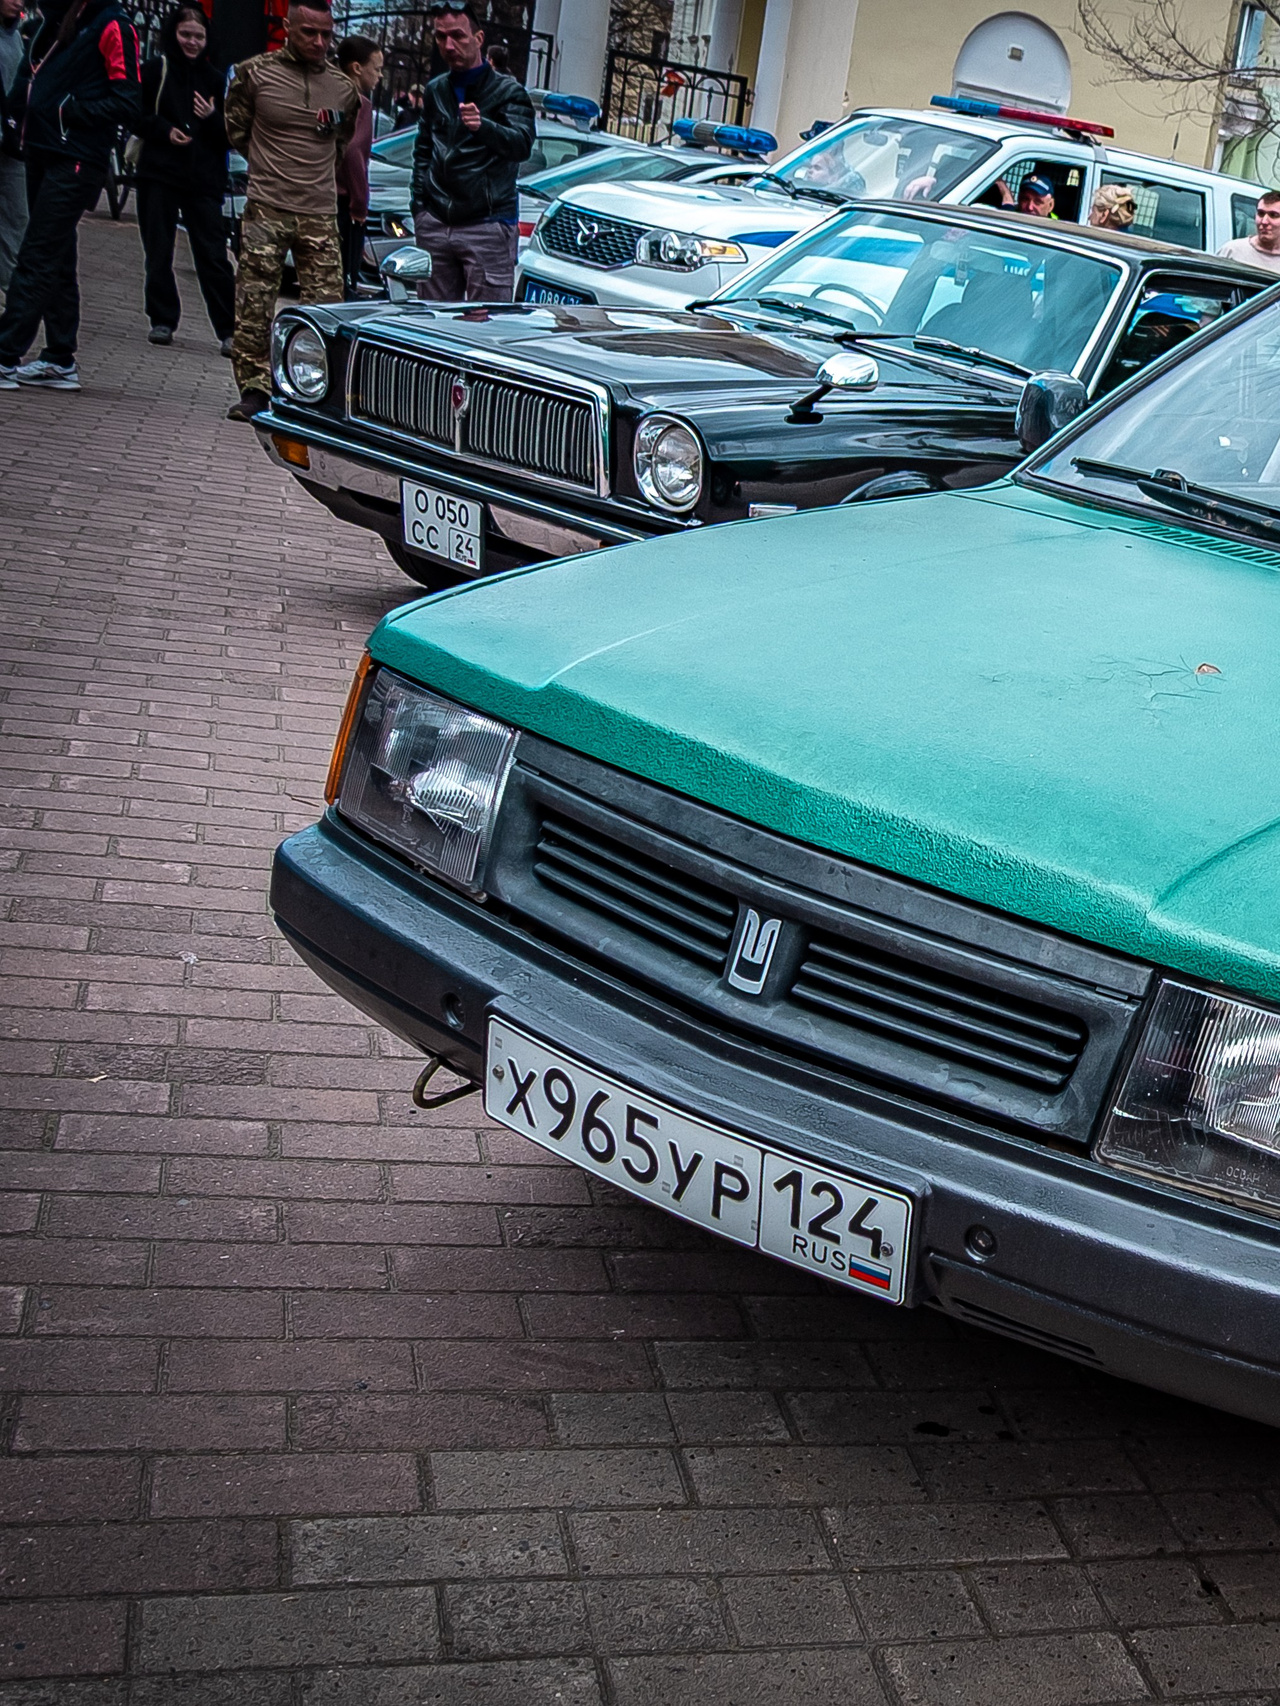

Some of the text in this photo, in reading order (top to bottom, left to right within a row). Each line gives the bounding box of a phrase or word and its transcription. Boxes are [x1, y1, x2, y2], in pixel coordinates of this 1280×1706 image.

[412, 520, 473, 558] СС 24
[506, 1056, 882, 1260] Х965УР 124
[793, 1236, 847, 1272] RUS
